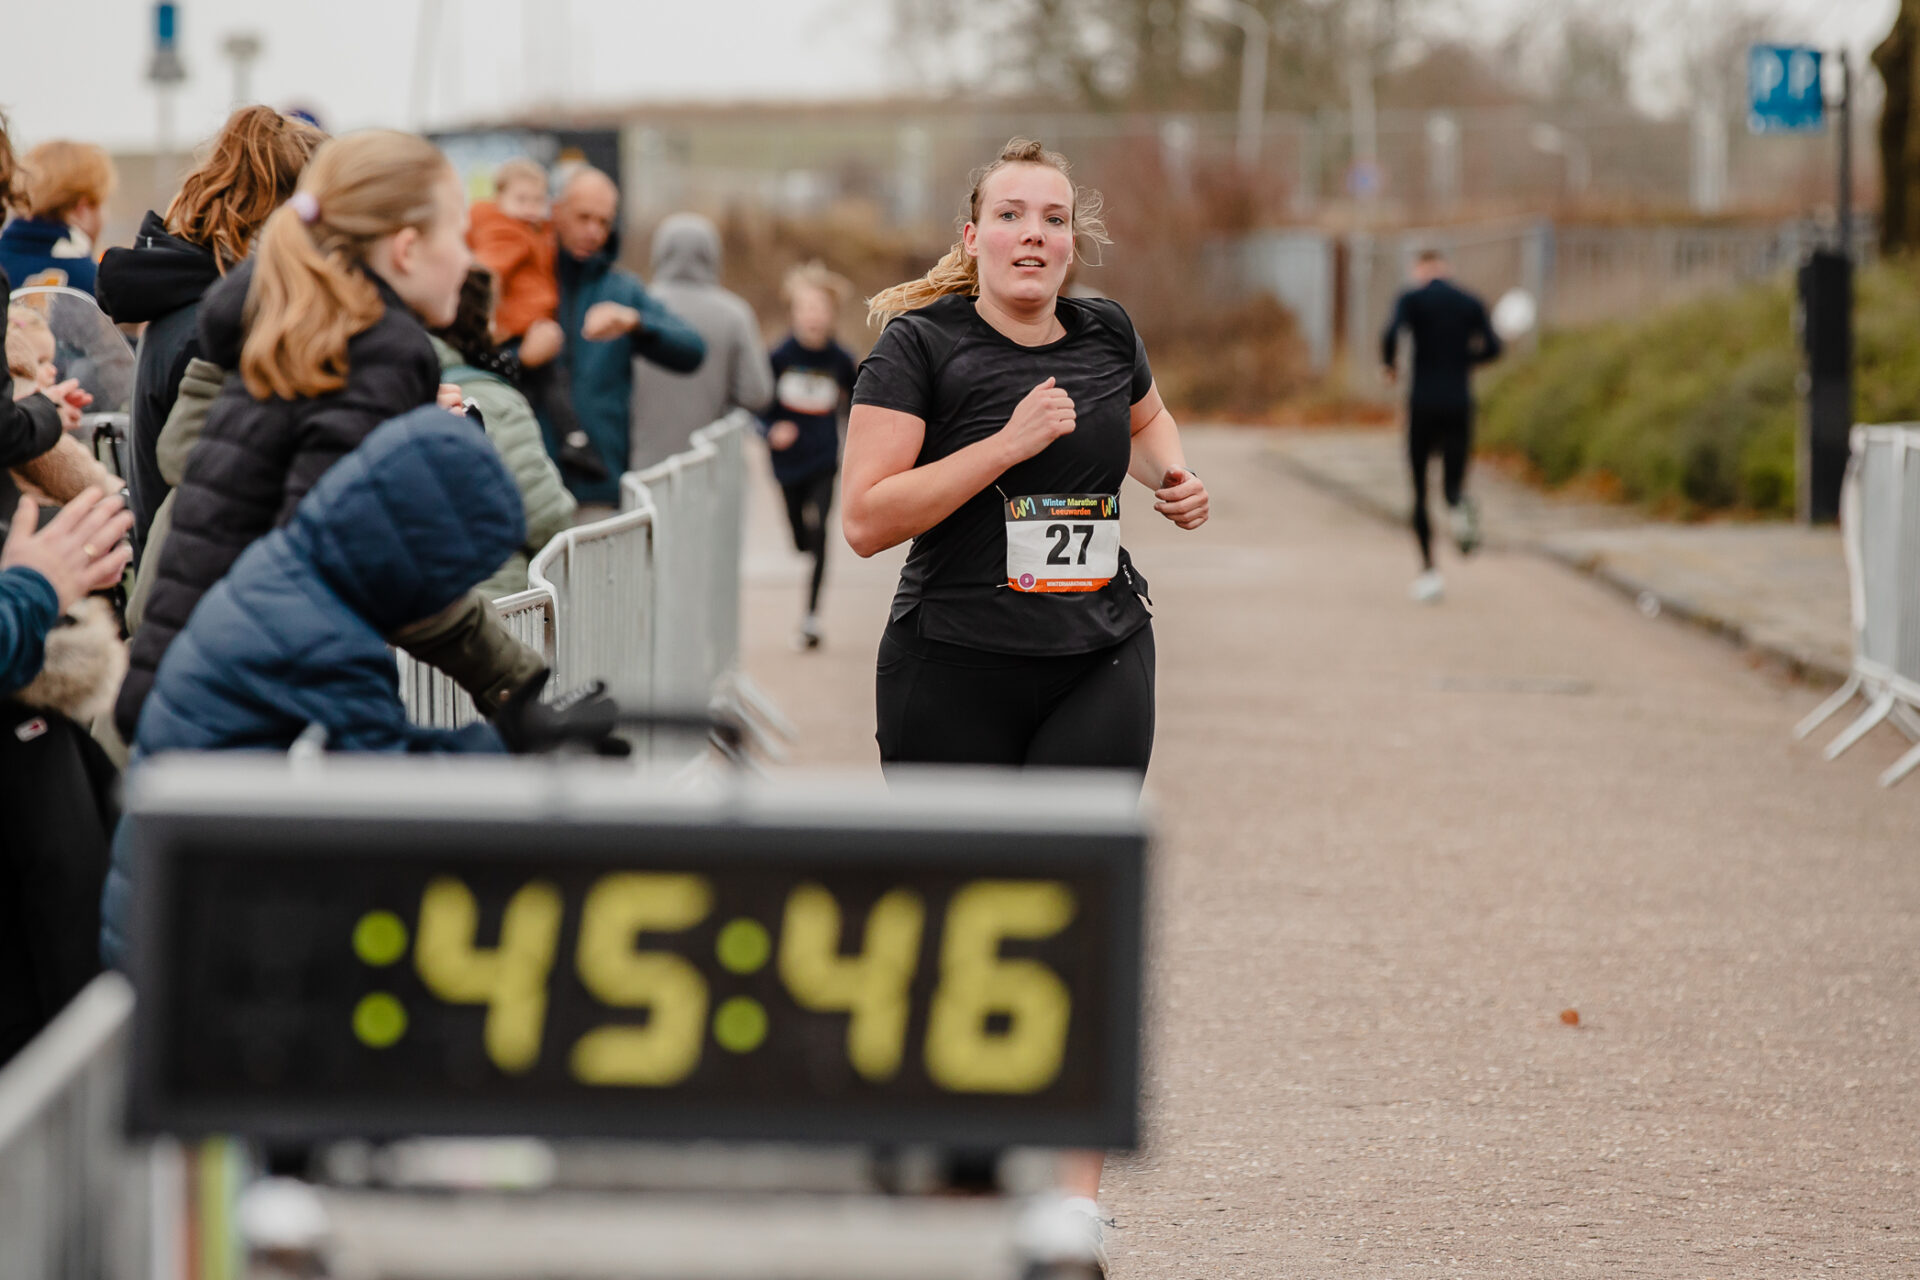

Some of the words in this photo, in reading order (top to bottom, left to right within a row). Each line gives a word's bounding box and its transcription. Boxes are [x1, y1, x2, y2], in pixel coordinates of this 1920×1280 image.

[1042, 498, 1066, 506] Winter
[1067, 498, 1098, 506] Marathon
[1051, 507, 1091, 515] Leeuwarden
[1045, 523, 1095, 566] 27
